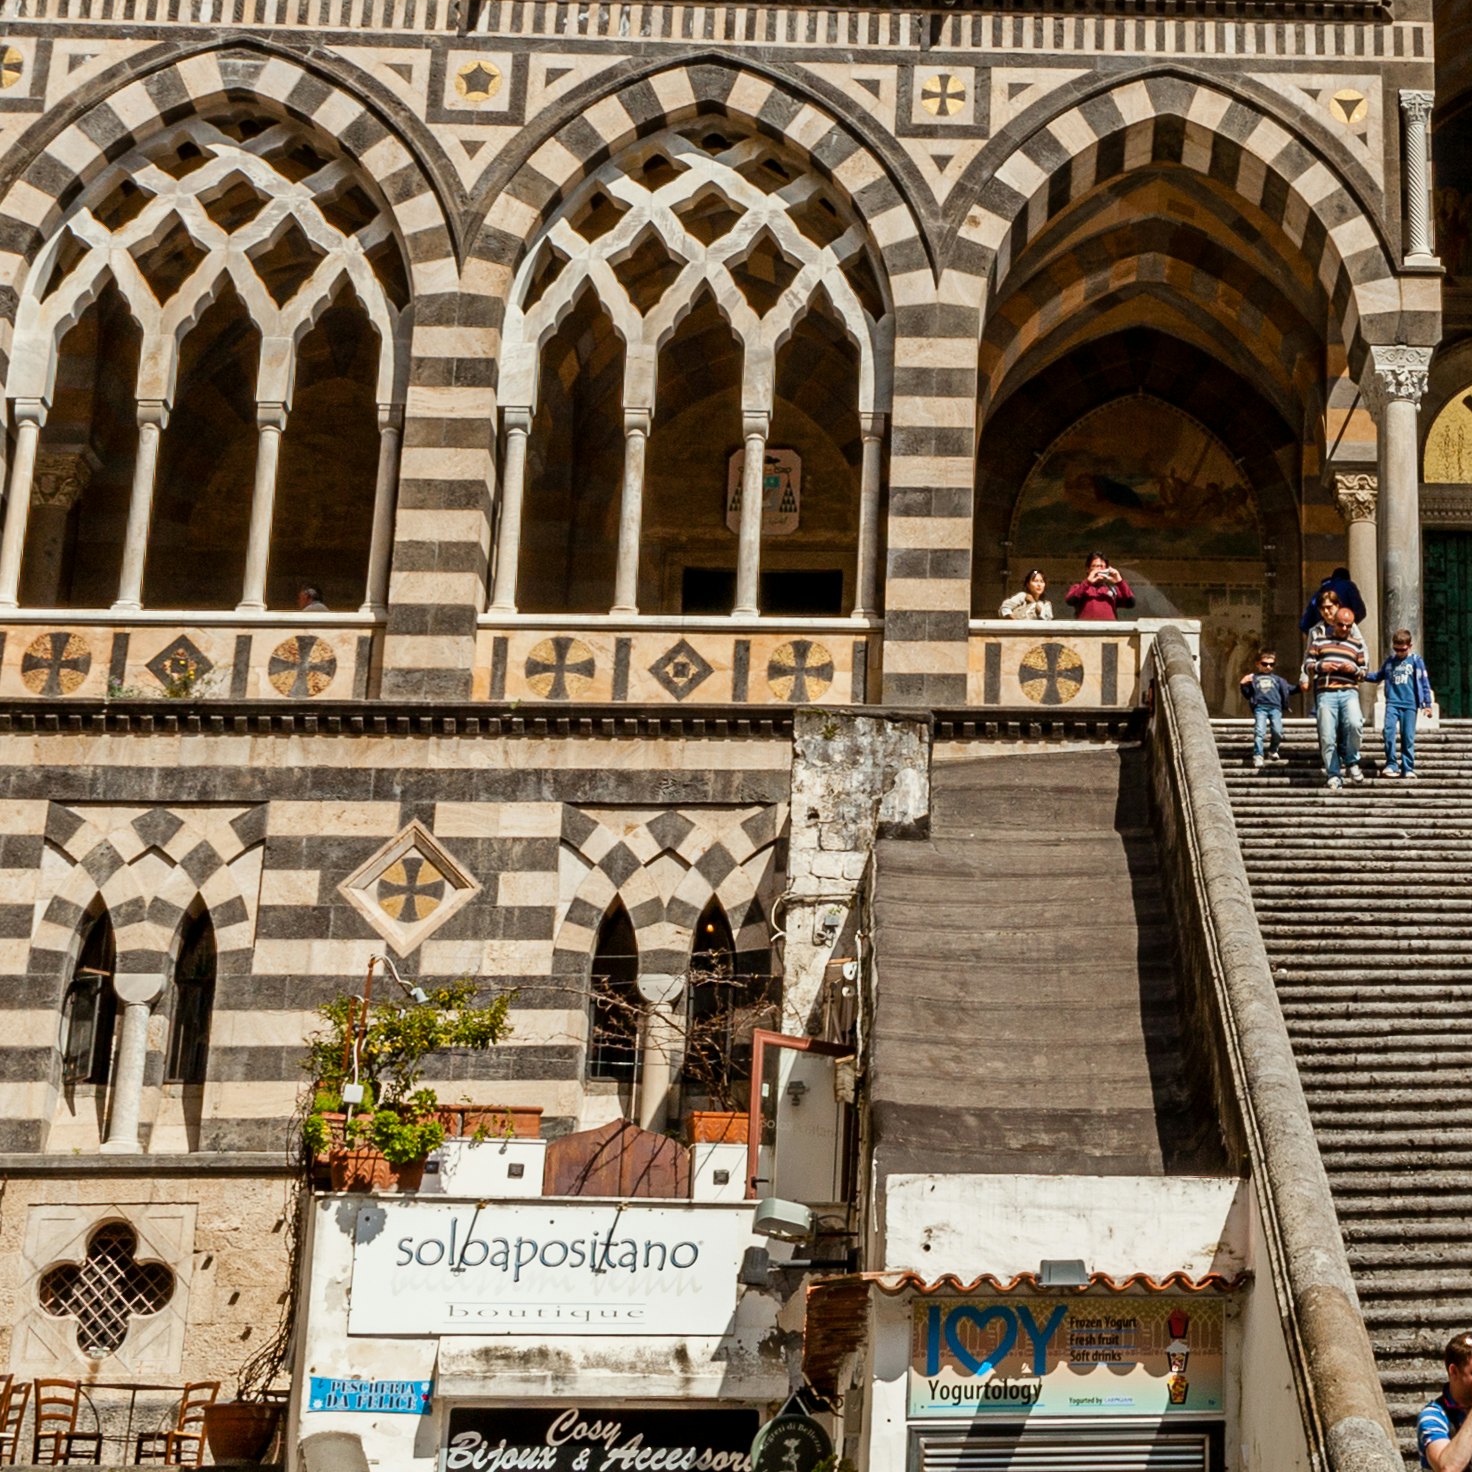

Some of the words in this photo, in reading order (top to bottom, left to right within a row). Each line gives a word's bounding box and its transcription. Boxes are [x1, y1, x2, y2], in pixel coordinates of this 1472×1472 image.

[448, 1304, 645, 1321] boutique
[1069, 1316, 1102, 1328] Frozen
[1104, 1316, 1137, 1331] Yogurt
[926, 1304, 941, 1376] I
[1017, 1304, 1068, 1376] Y
[1069, 1333, 1096, 1345] Fresh
[1098, 1333, 1119, 1345] fruit
[1070, 1349, 1091, 1362] Soft
[1092, 1349, 1121, 1362] drinks
[331, 1381, 415, 1394] PESCHERIA
[928, 1379, 1042, 1406] Yogurtology
[327, 1394, 349, 1408] DA
[356, 1394, 416, 1409] FELICE
[546, 1407, 621, 1451] Cosy
[447, 1430, 557, 1472] Bijoux
[571, 1447, 591, 1471] &
